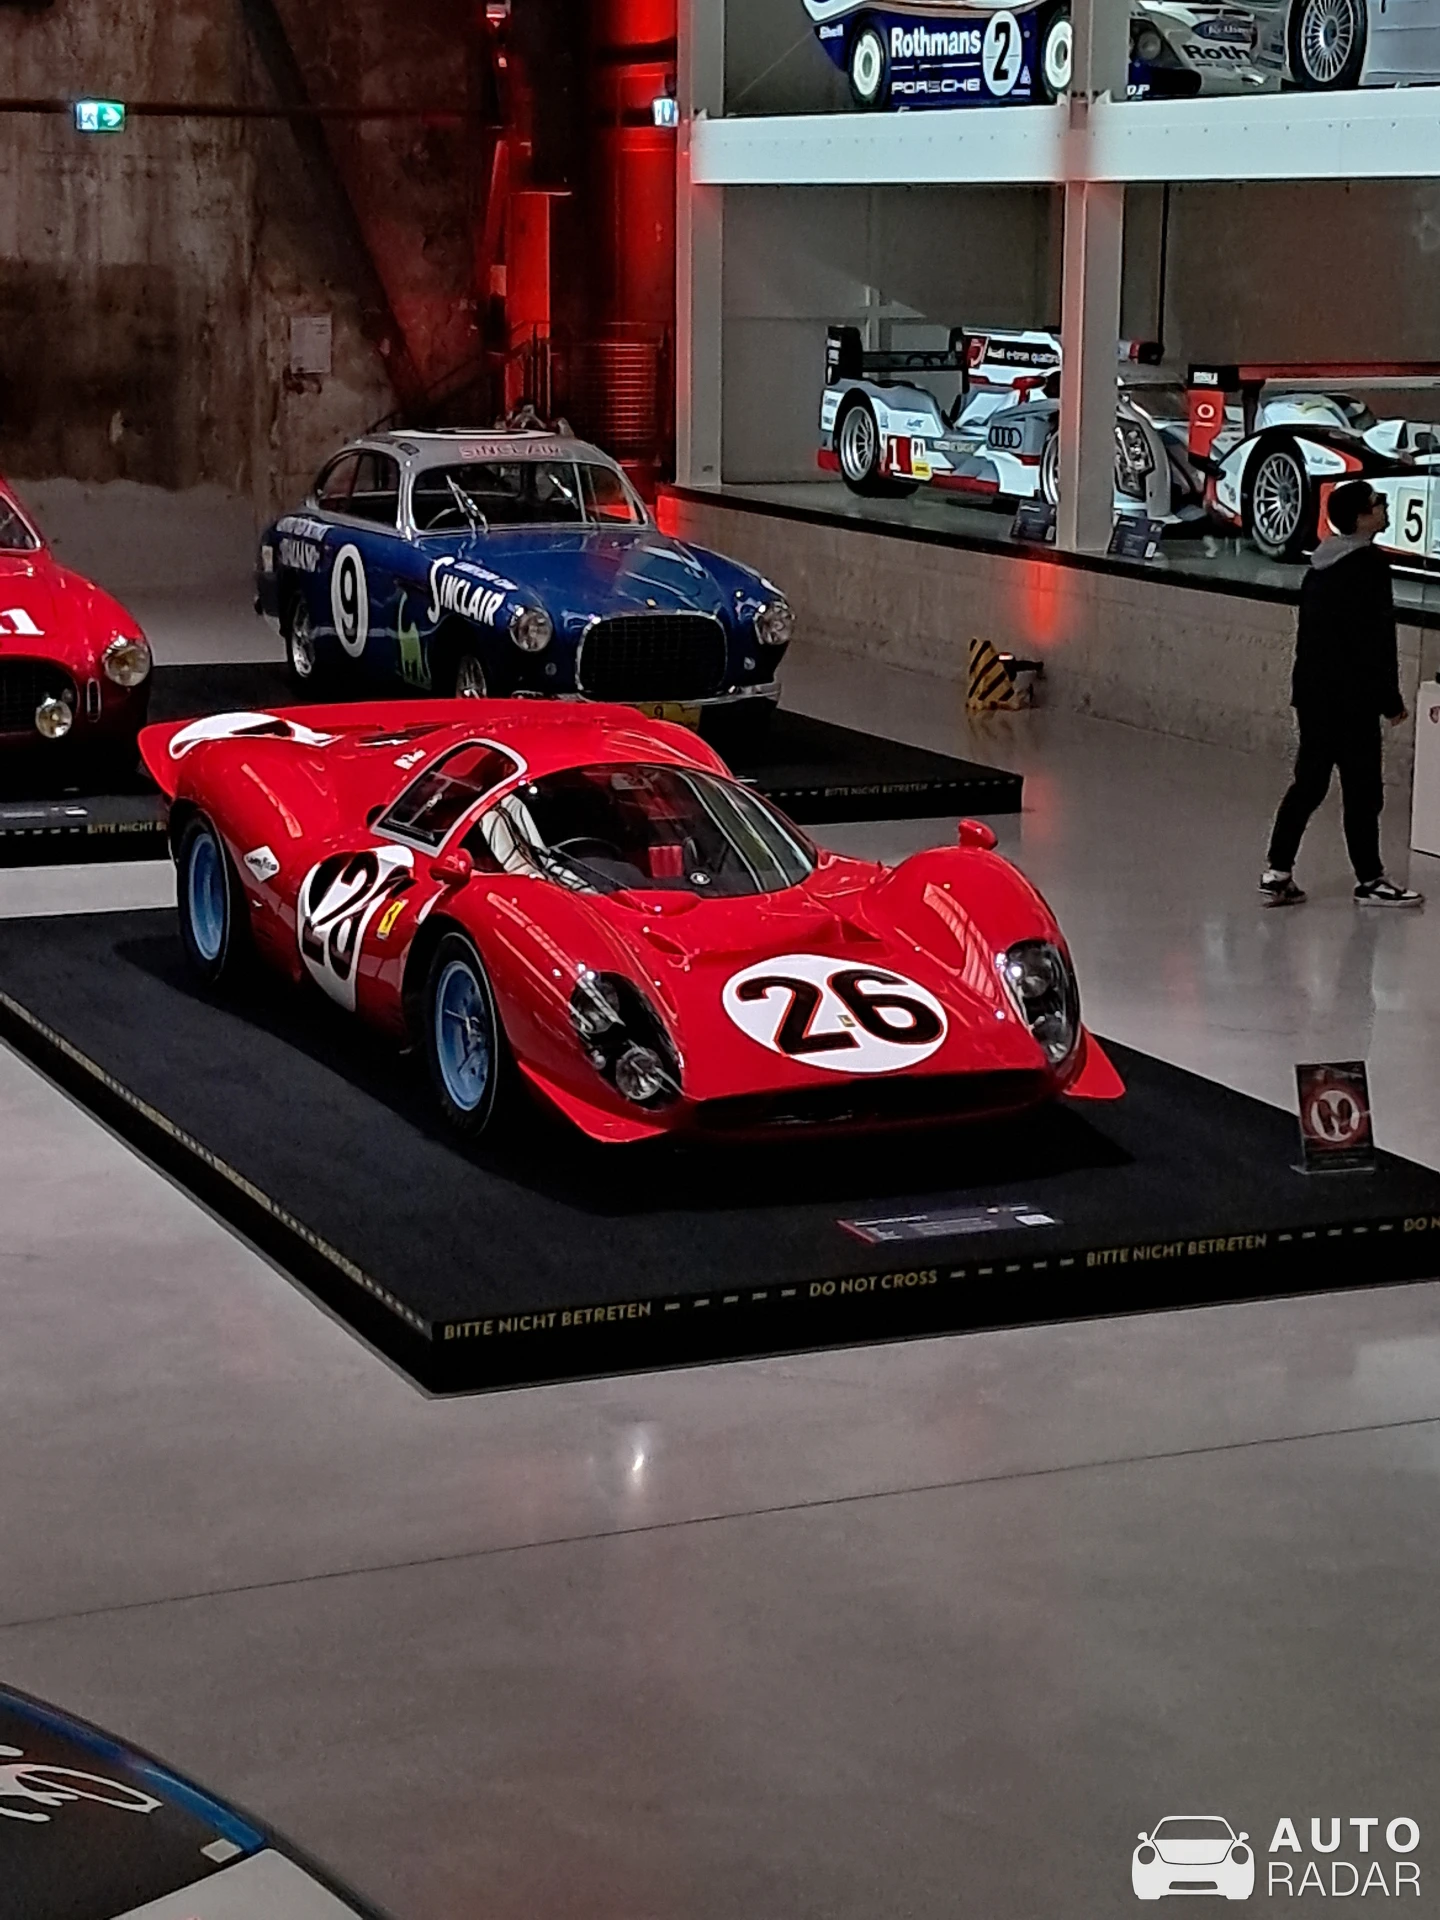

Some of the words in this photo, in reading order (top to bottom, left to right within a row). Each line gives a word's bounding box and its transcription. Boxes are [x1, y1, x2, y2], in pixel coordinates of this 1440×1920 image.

[891, 26, 981, 58] Rothmans
[993, 21, 1011, 81] 2
[891, 78, 981, 95] PORSCHE
[889, 438, 902, 472] 1
[1404, 498, 1424, 543] 5
[339, 554, 359, 637] 9
[736, 968, 945, 1056] 26
[1403, 1217, 1427, 1233] DO
[1086, 1247, 1129, 1268] BITTE
[1132, 1240, 1185, 1262] NICHT
[1187, 1233, 1268, 1256] BETRETEN
[809, 1280, 836, 1298] DO
[840, 1275, 878, 1295] NOT
[881, 1268, 938, 1290] CROSS
[444, 1320, 494, 1340] BITTE
[498, 1312, 556, 1334] NICHT
[561, 1301, 652, 1327] BETRETEN
